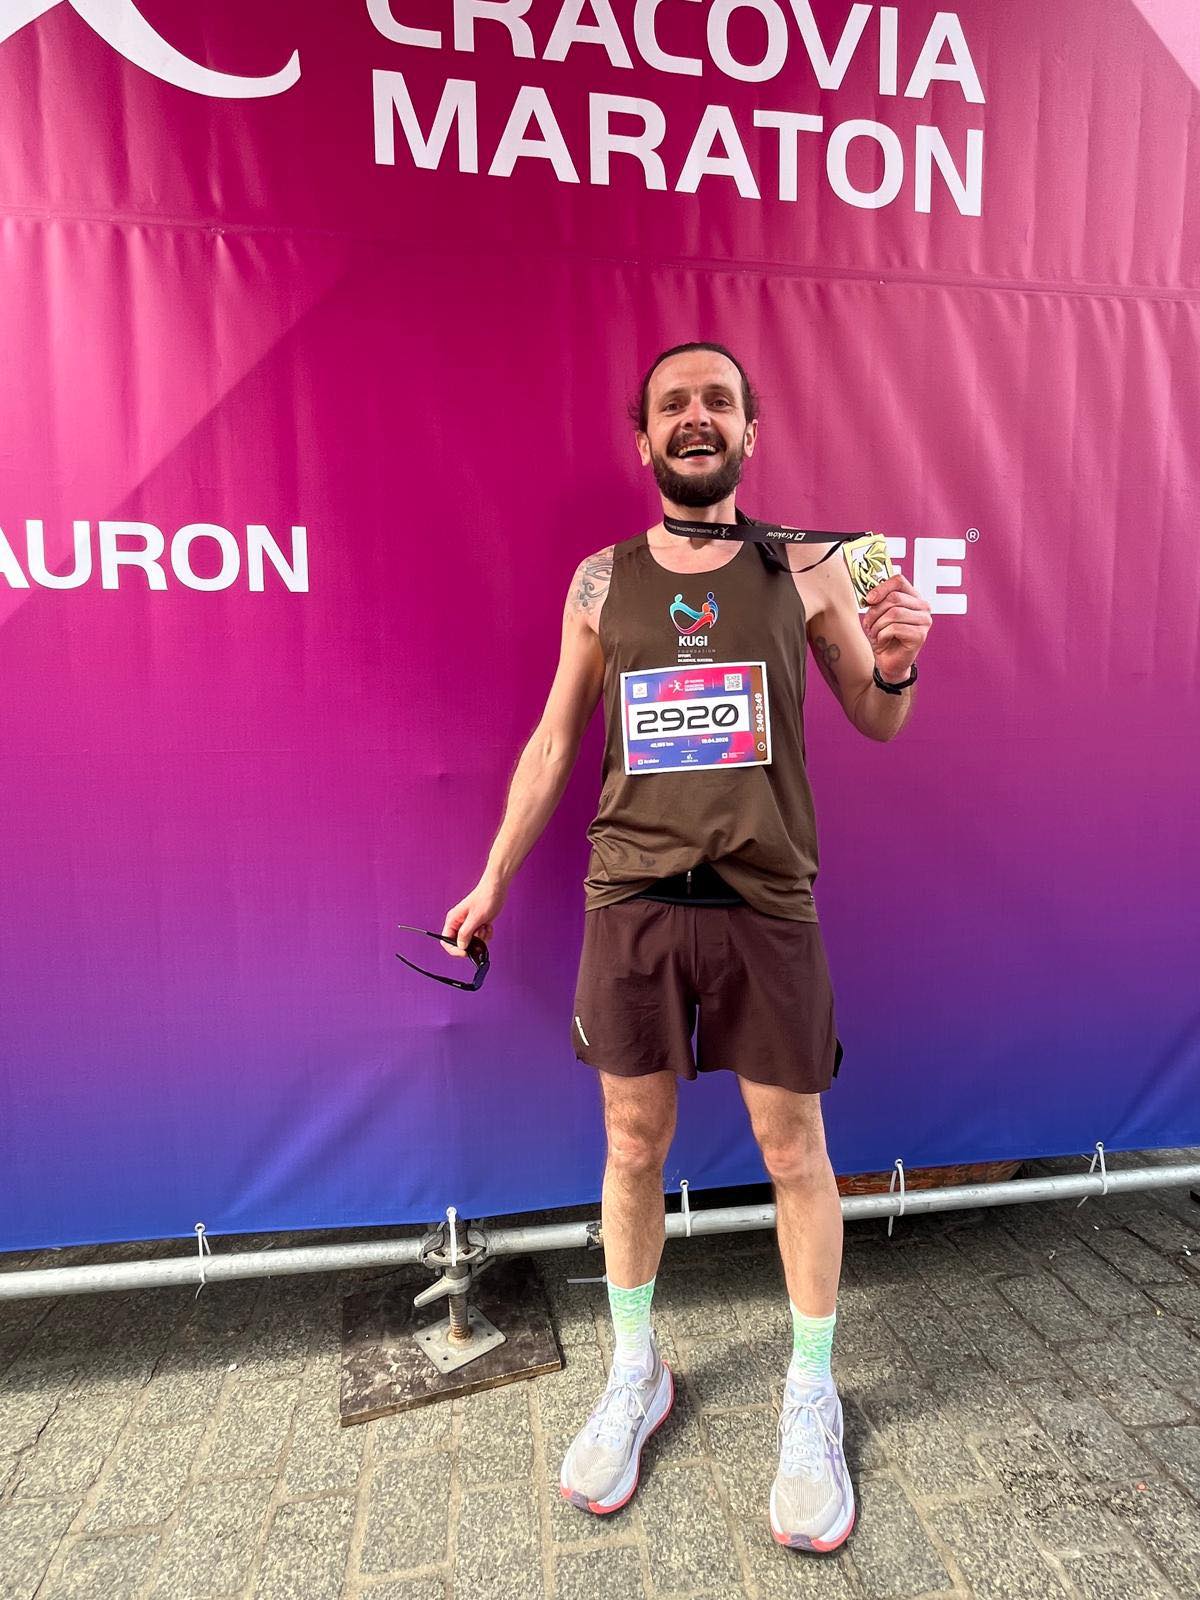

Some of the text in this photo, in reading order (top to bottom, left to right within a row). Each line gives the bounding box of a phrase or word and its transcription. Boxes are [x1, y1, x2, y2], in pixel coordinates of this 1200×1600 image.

[365, 0, 986, 104] CRACOVIA
[372, 68, 984, 217] MARATON
[678, 635, 708, 647] KUGI
[636, 703, 739, 734] 2920
